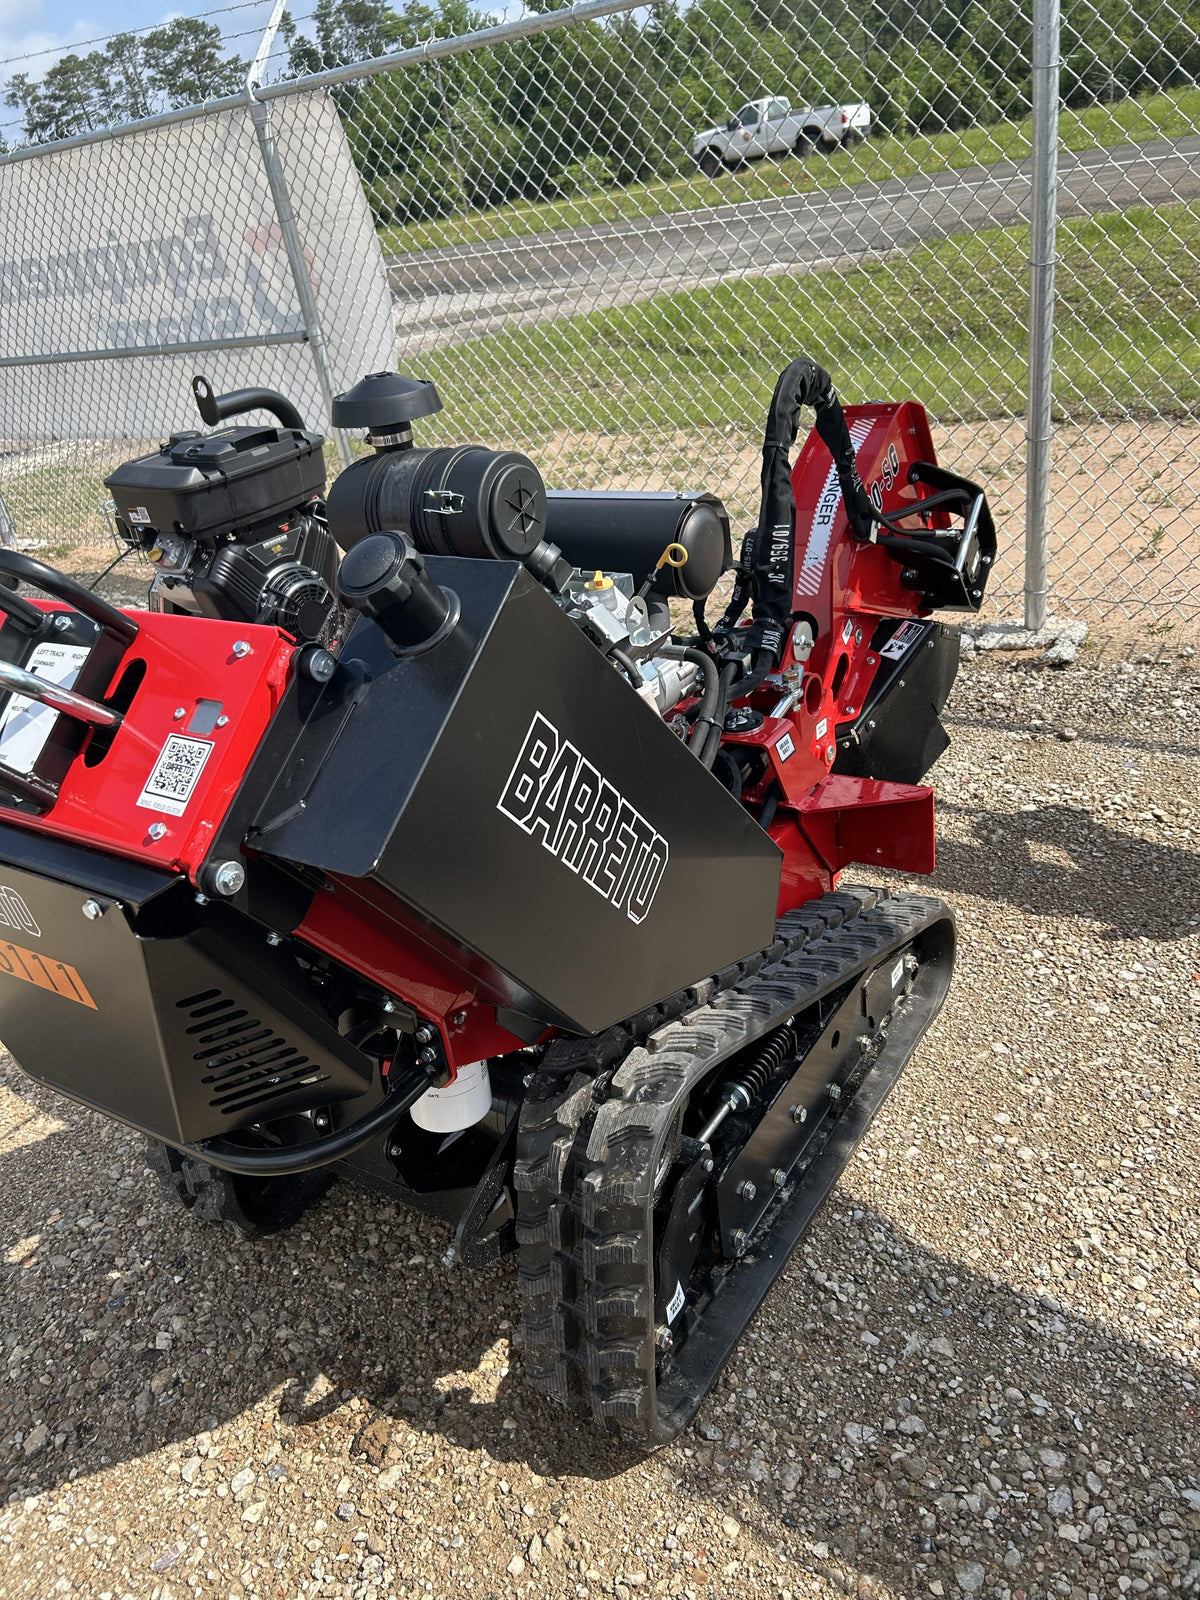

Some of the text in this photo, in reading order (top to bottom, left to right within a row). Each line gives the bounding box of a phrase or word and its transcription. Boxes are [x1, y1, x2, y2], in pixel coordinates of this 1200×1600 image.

[816, 471, 841, 526] ANGER
[770, 523, 791, 562] 359/01
[165, 762, 192, 775] BARRETO
[497, 710, 669, 925] BARRETO
